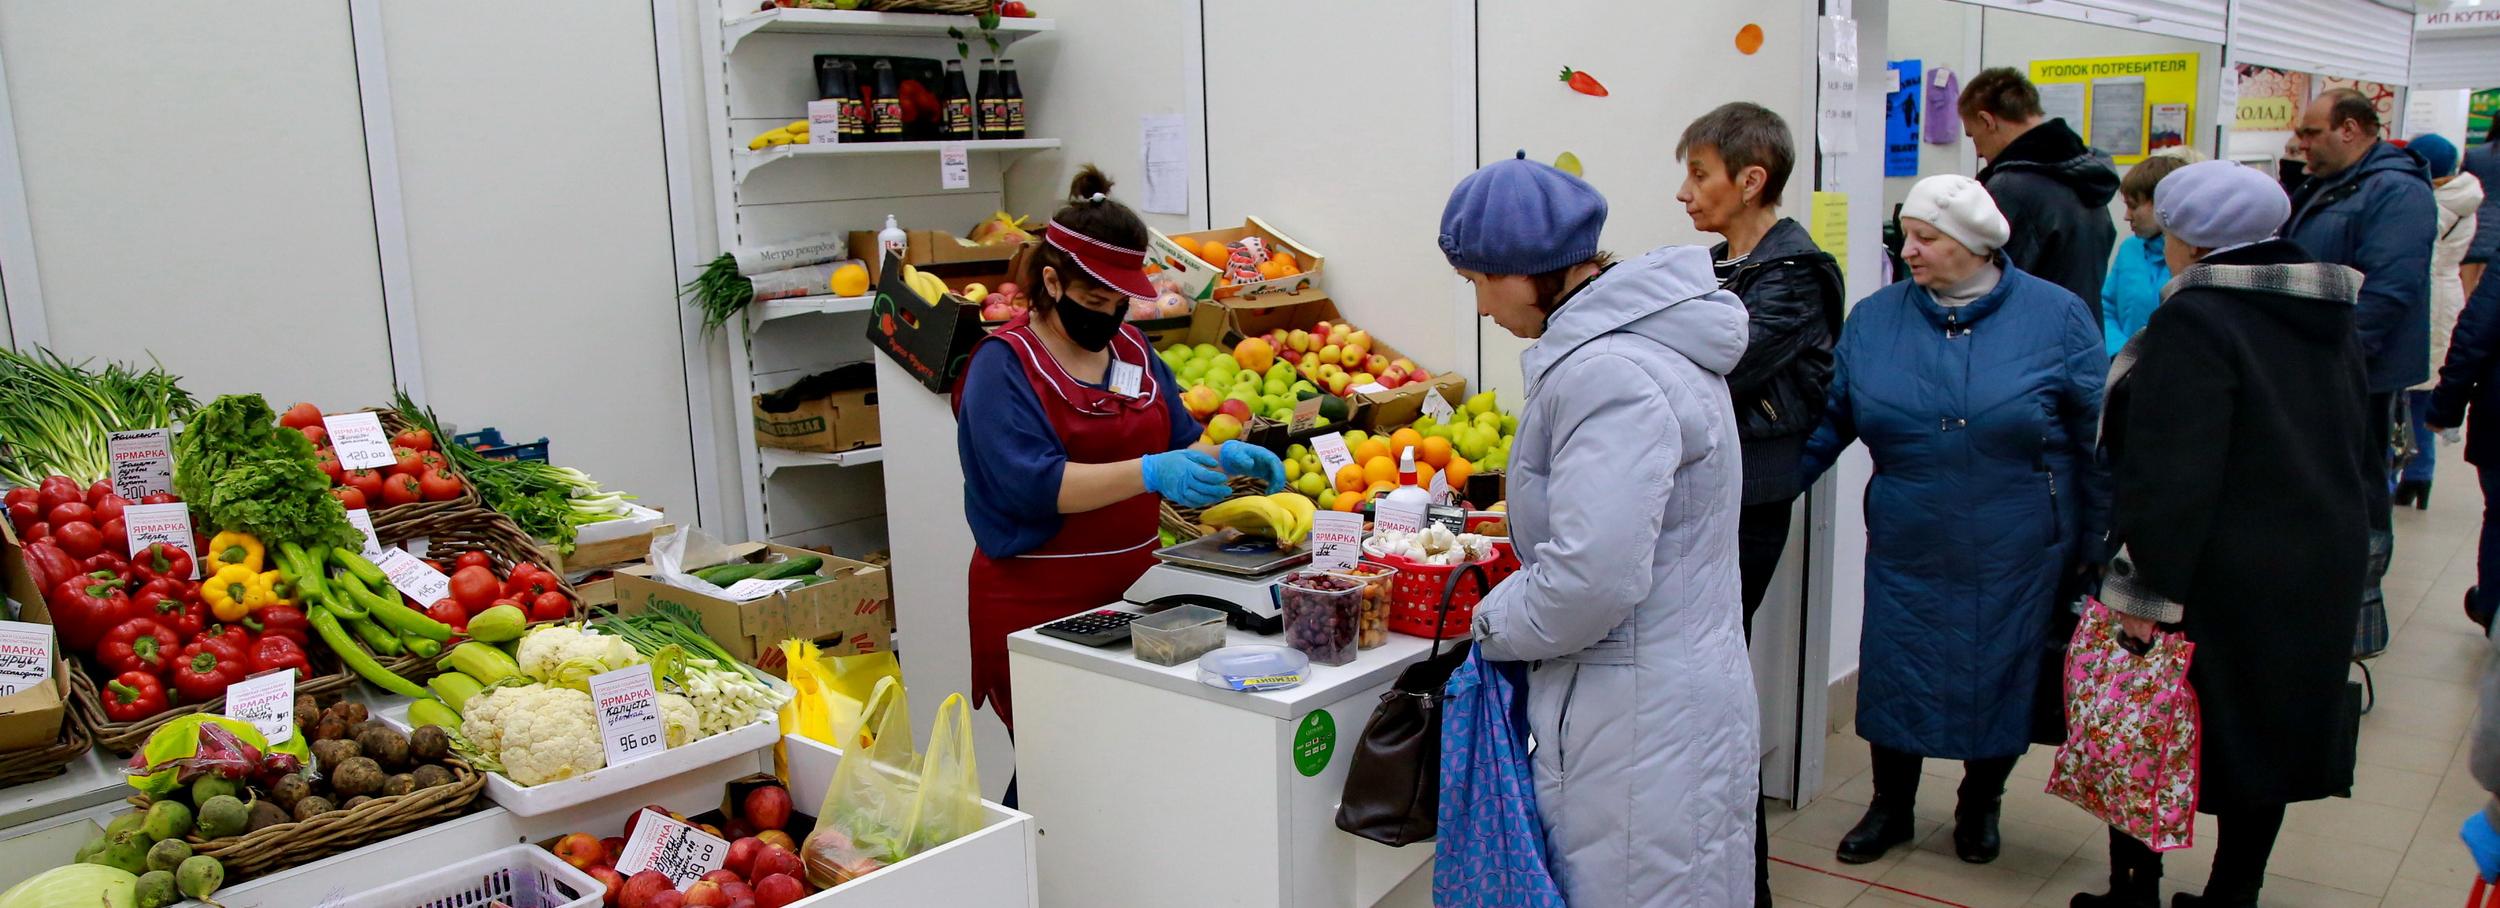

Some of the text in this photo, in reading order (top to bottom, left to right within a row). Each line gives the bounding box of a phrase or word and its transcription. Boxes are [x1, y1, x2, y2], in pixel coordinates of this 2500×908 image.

[2427, 12, 2450, 24] ИП
[2041, 59, 2187, 77] УГОЛОК ПОТРЕБИТЕЛЯ
[760, 241, 836, 262] Метро рекордов
[333, 426, 379, 435] ЯРМАРКА
[115, 449, 166, 461] ЯРМАРКА
[346, 450, 387, 461] 120 00
[123, 485, 147, 500] 200
[133, 522, 186, 534] ЯРМАРКА
[1378, 519, 1417, 534] ЯРМАРКА
[1315, 532, 1357, 544] ЯРМАРКА
[0, 644, 46, 657] МАРКА
[1255, 675, 1298, 684] РЕМОНТ
[232, 690, 289, 712] ЯРМАРКА
[600, 688, 652, 708] ЯРМАРКА
[605, 699, 651, 717] Капуста
[620, 734, 657, 752] 96 00
[687, 844, 714, 880] 99 00
